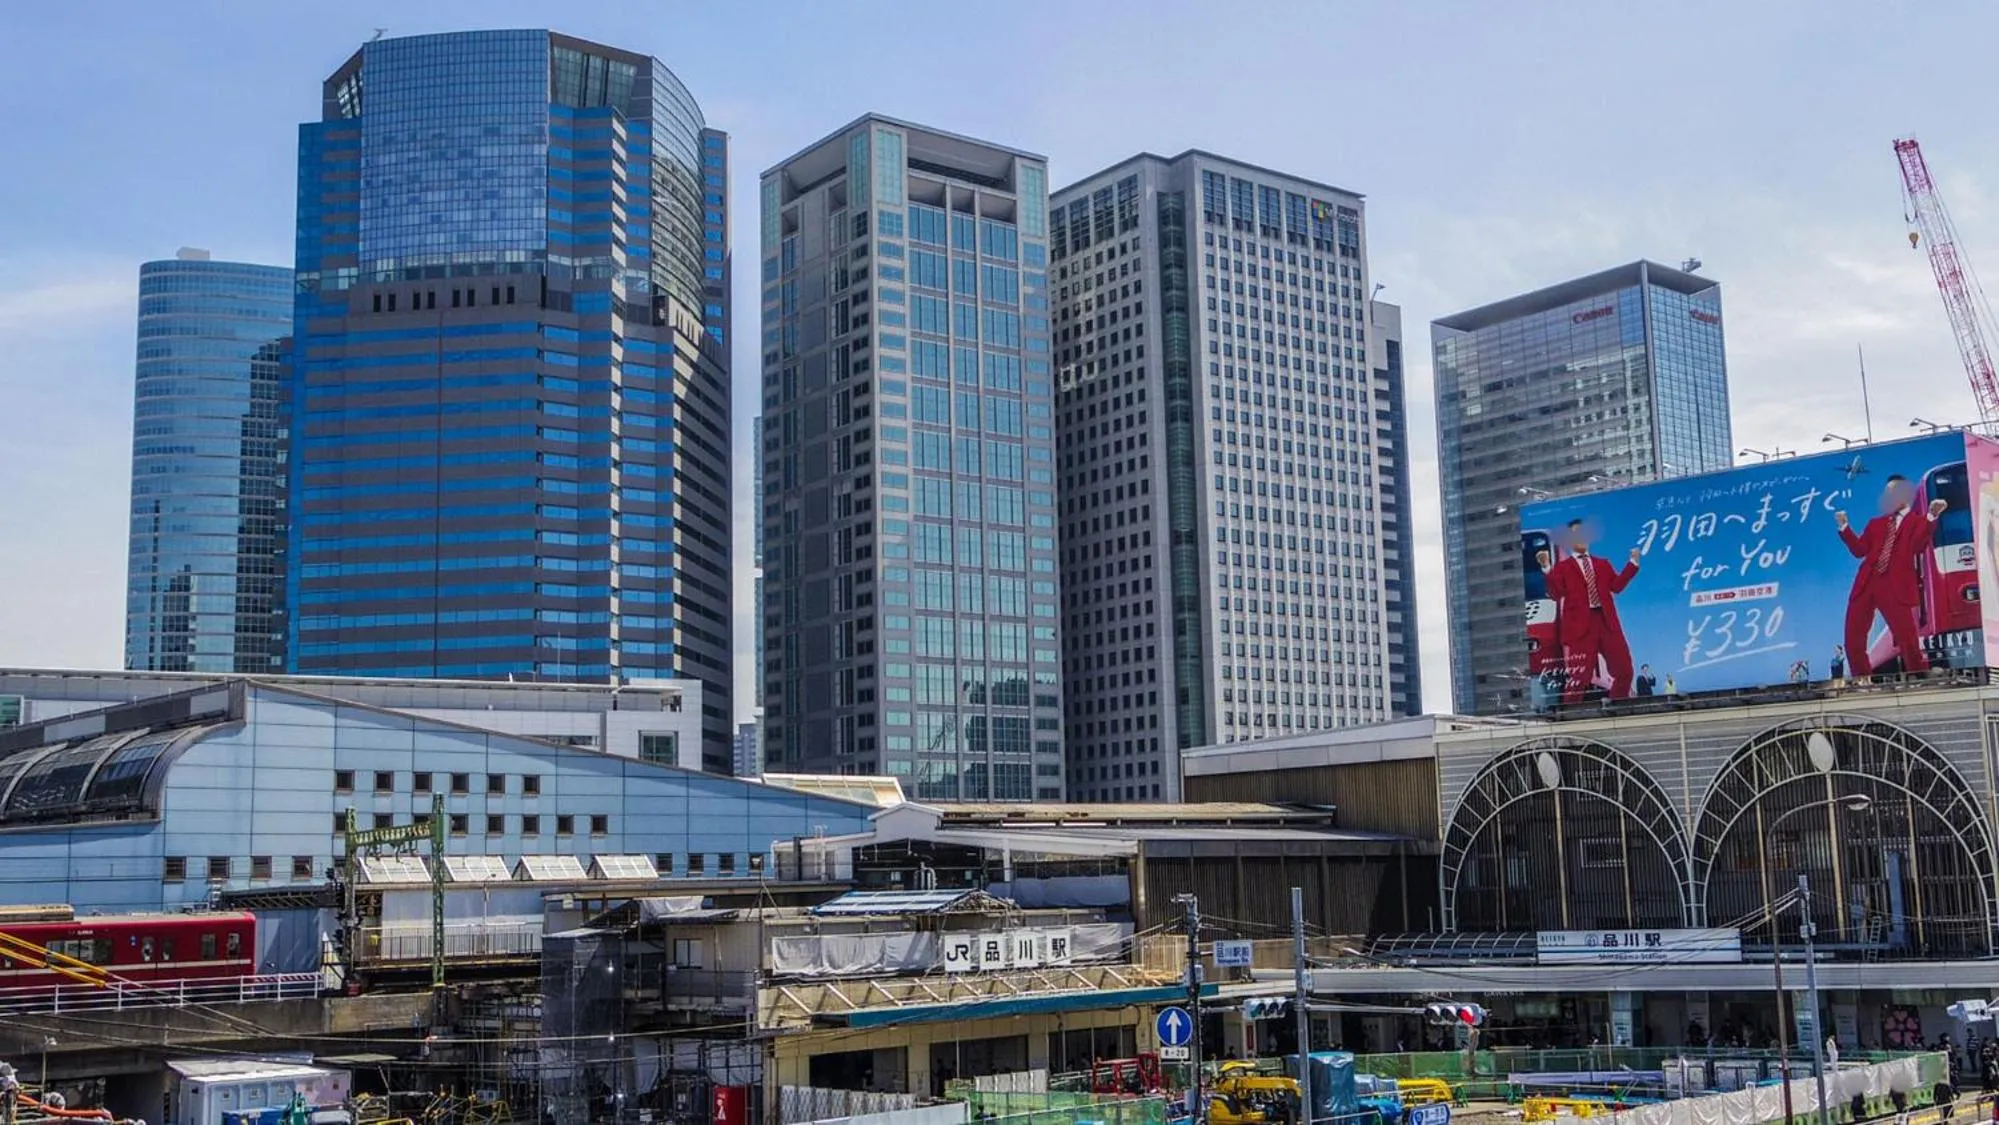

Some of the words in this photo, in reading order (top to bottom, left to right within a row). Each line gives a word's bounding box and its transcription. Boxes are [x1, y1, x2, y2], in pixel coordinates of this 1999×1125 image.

[1637, 486, 1852, 556] 羽田へまっすぐ
[1682, 556, 1729, 591] for
[1740, 538, 1792, 576] You
[1683, 605, 1785, 665] ¥330
[1918, 631, 1974, 650] KEIKYU
[946, 944, 969, 962] JR
[985, 938, 1066, 962] 品川駅
[1602, 932, 1662, 947] 品川駅
